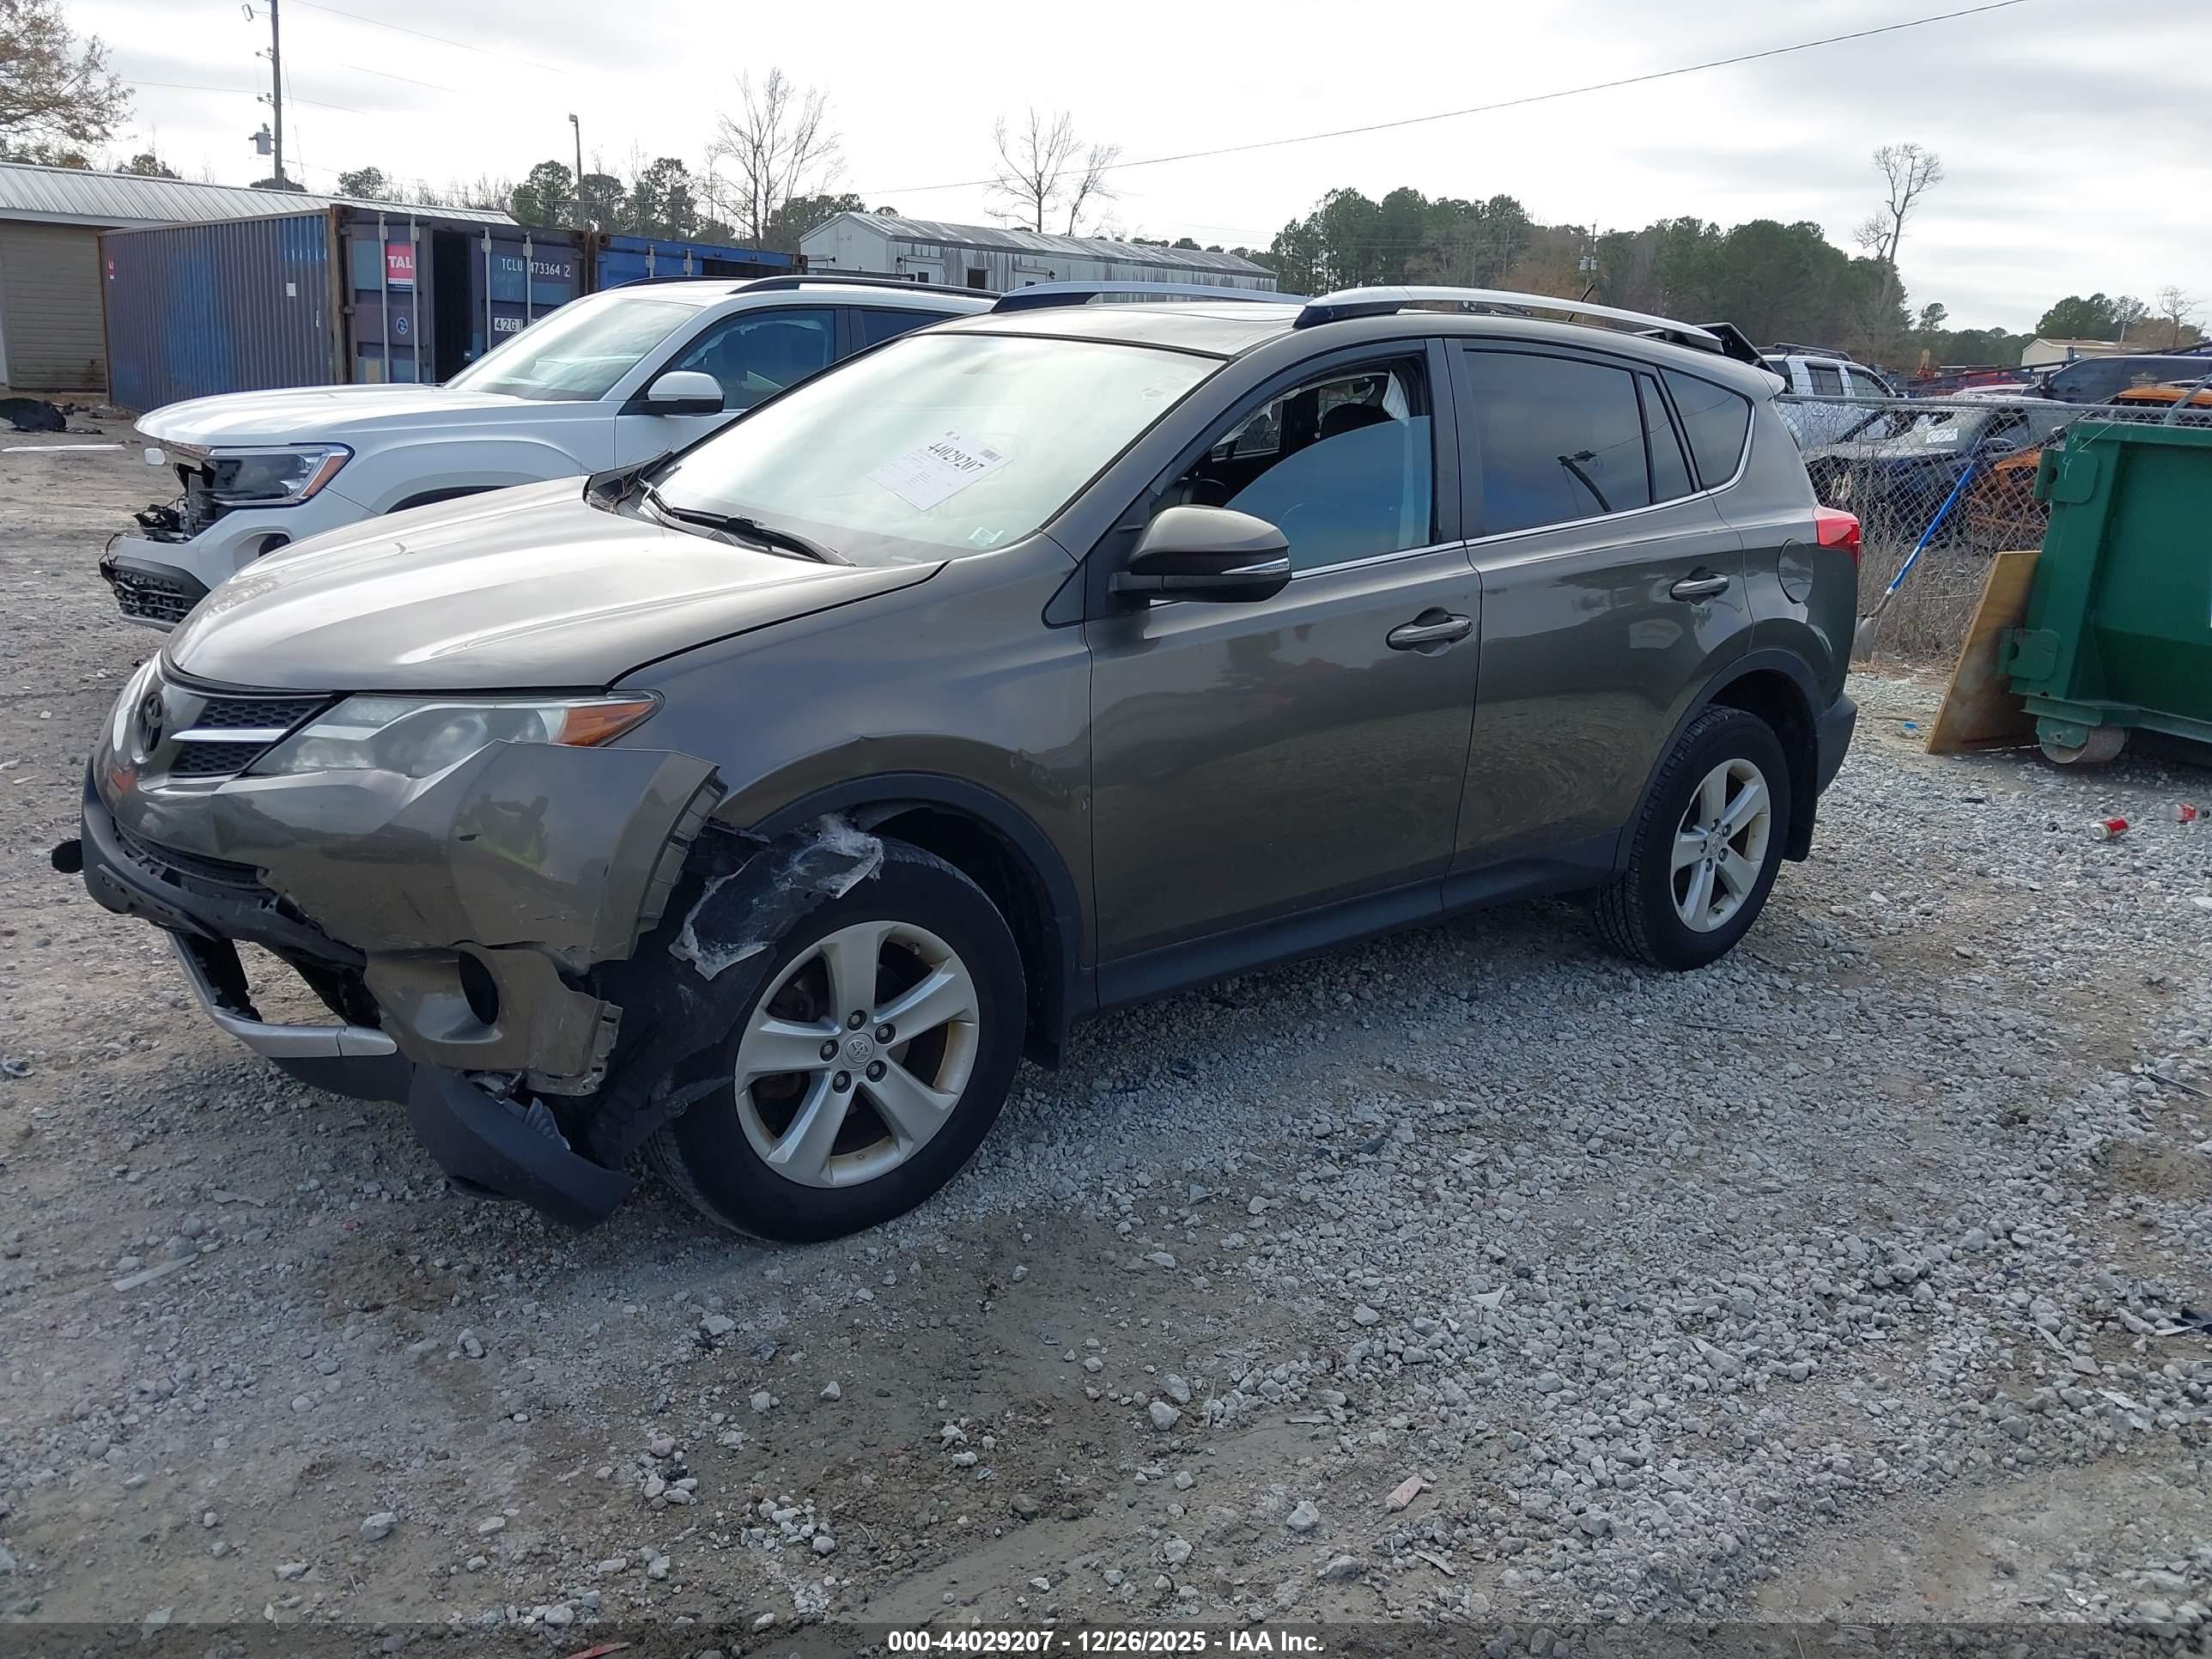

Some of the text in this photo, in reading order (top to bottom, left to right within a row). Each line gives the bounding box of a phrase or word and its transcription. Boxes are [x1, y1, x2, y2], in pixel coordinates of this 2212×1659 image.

[387, 255, 412, 269] TAL
[501, 258, 523, 272] TCLU
[495, 319, 522, 331] 42G1
[927, 441, 986, 474] 44029207
